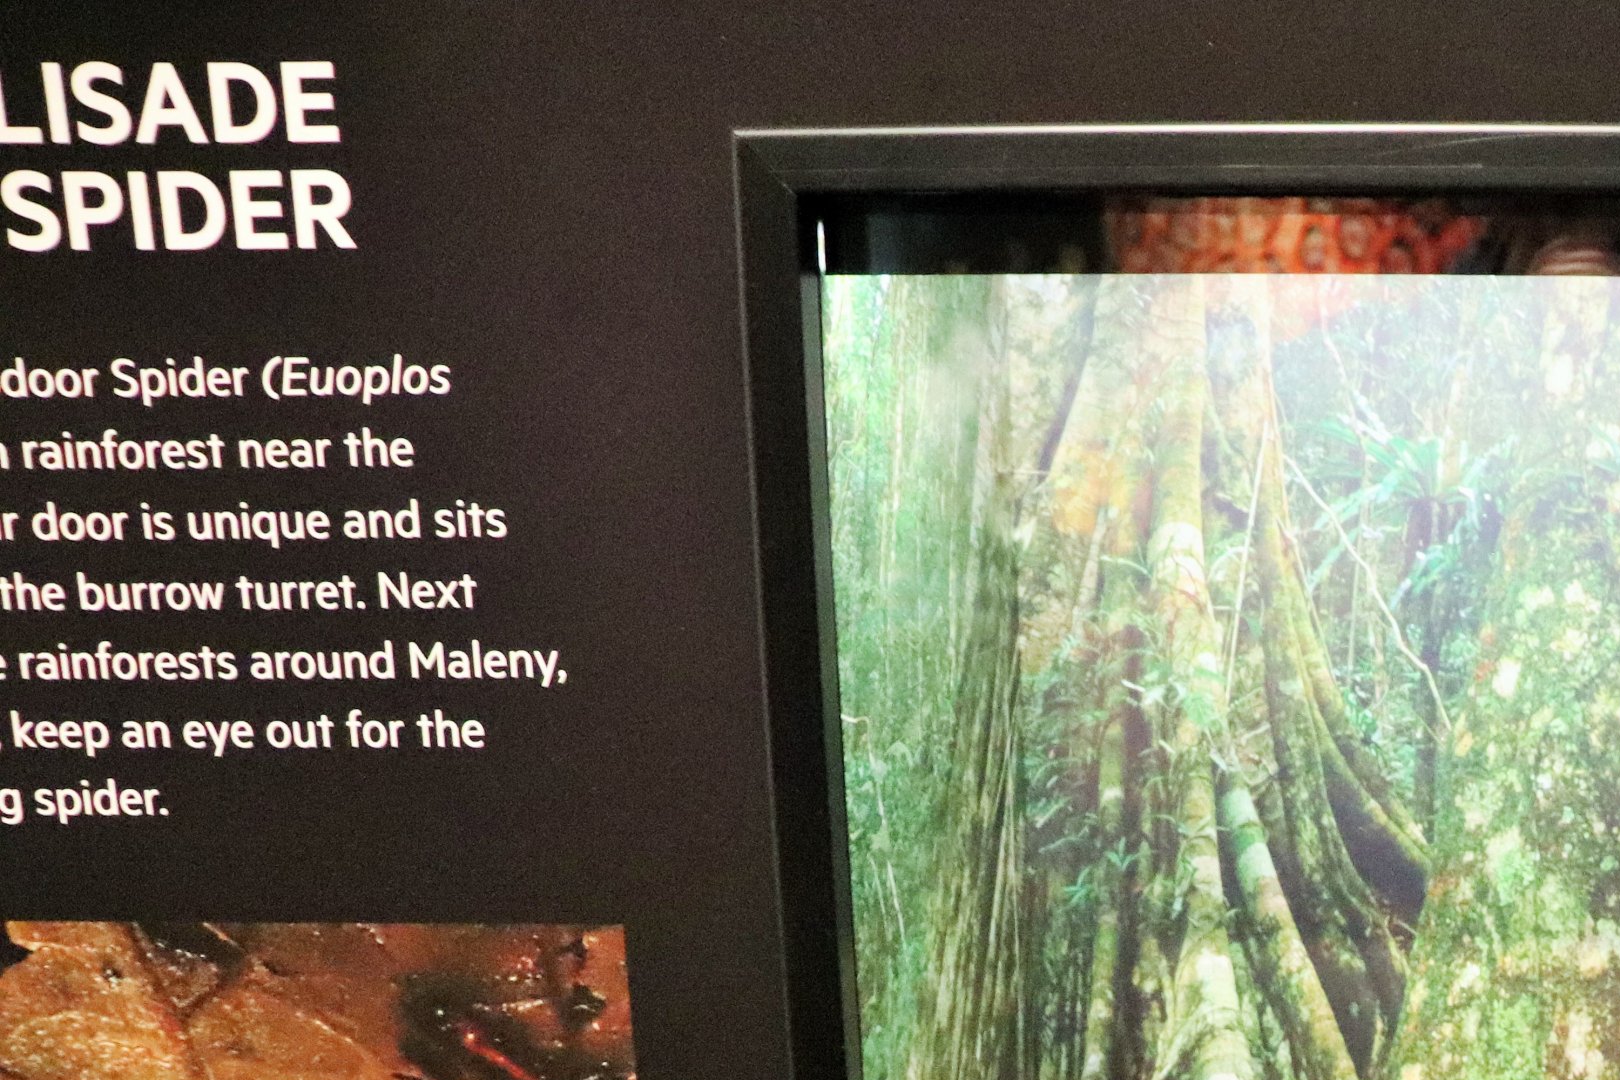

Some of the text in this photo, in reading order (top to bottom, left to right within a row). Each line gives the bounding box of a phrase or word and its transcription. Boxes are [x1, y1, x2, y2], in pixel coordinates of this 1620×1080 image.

[0, 60, 341, 146] LISADE
[0, 169, 358, 252] SPIDER
[110, 355, 249, 407] Spider
[261, 353, 451, 405] (Euoplos
[21, 428, 225, 470] rainforest
[238, 438, 332, 469] near
[342, 426, 415, 468] the
[31, 501, 129, 541] door
[140, 502, 176, 541] is
[187, 501, 331, 549] unique
[343, 498, 421, 540] and
[434, 499, 508, 539] sits
[0, 571, 477, 611] the burrow turret. Next
[18, 640, 238, 681] rainforests
[250, 639, 396, 680] around
[408, 639, 568, 688] Maleny,
[10, 708, 486, 757] keep an eye out for the
[34, 778, 169, 825] spider.
